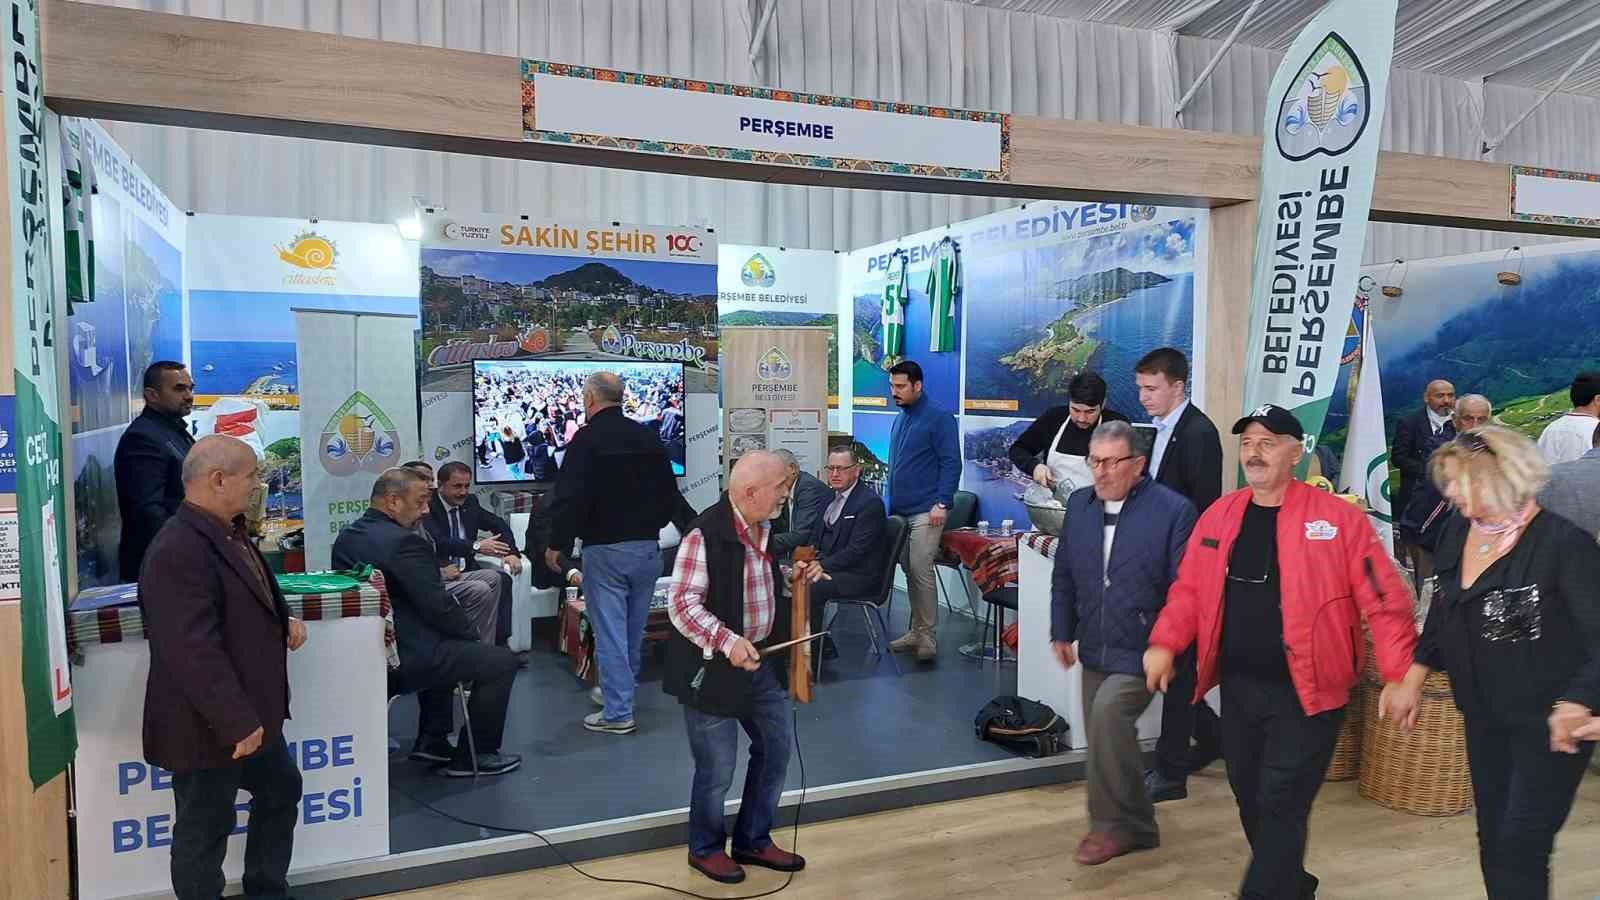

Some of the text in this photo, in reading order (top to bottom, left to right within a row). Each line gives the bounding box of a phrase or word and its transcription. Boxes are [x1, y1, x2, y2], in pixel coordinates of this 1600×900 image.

[740, 116, 834, 140] PERŞEMBE
[500, 223, 656, 255] SAKİN ŞEHİR
[112, 776, 363, 853] BEESİ
